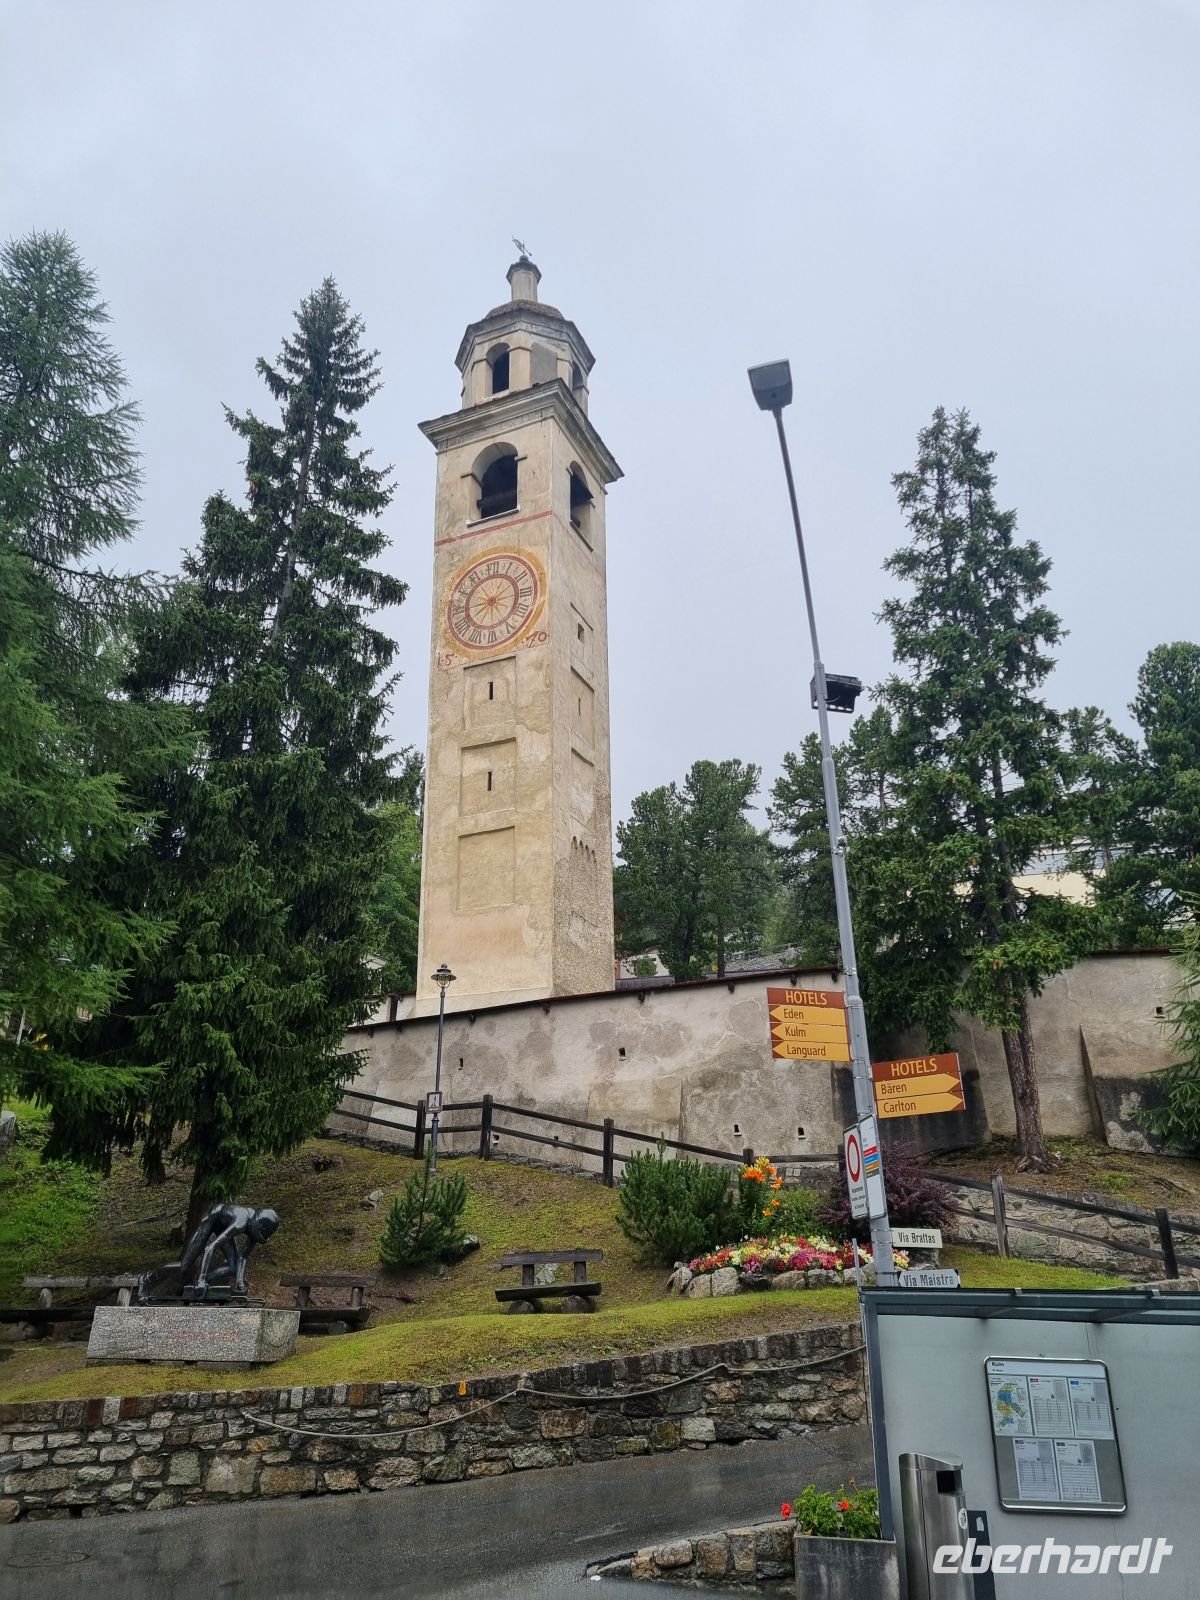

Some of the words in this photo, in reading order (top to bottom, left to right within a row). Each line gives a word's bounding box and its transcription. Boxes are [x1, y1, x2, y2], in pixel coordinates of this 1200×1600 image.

[519, 585, 533, 598] III
[785, 990, 827, 1005] HOTELS
[783, 1008, 804, 1020] Eden
[785, 1026, 807, 1038] Kulm
[786, 1044, 827, 1058] Languard
[891, 1058, 938, 1077] HOTELS
[881, 1082, 907, 1095] Bären
[883, 1100, 917, 1114] Carlton
[898, 1232, 909, 1243] Via
[911, 1232, 936, 1244] Brattas
[903, 1275, 917, 1287] Via
[920, 1274, 954, 1287] Maistra
